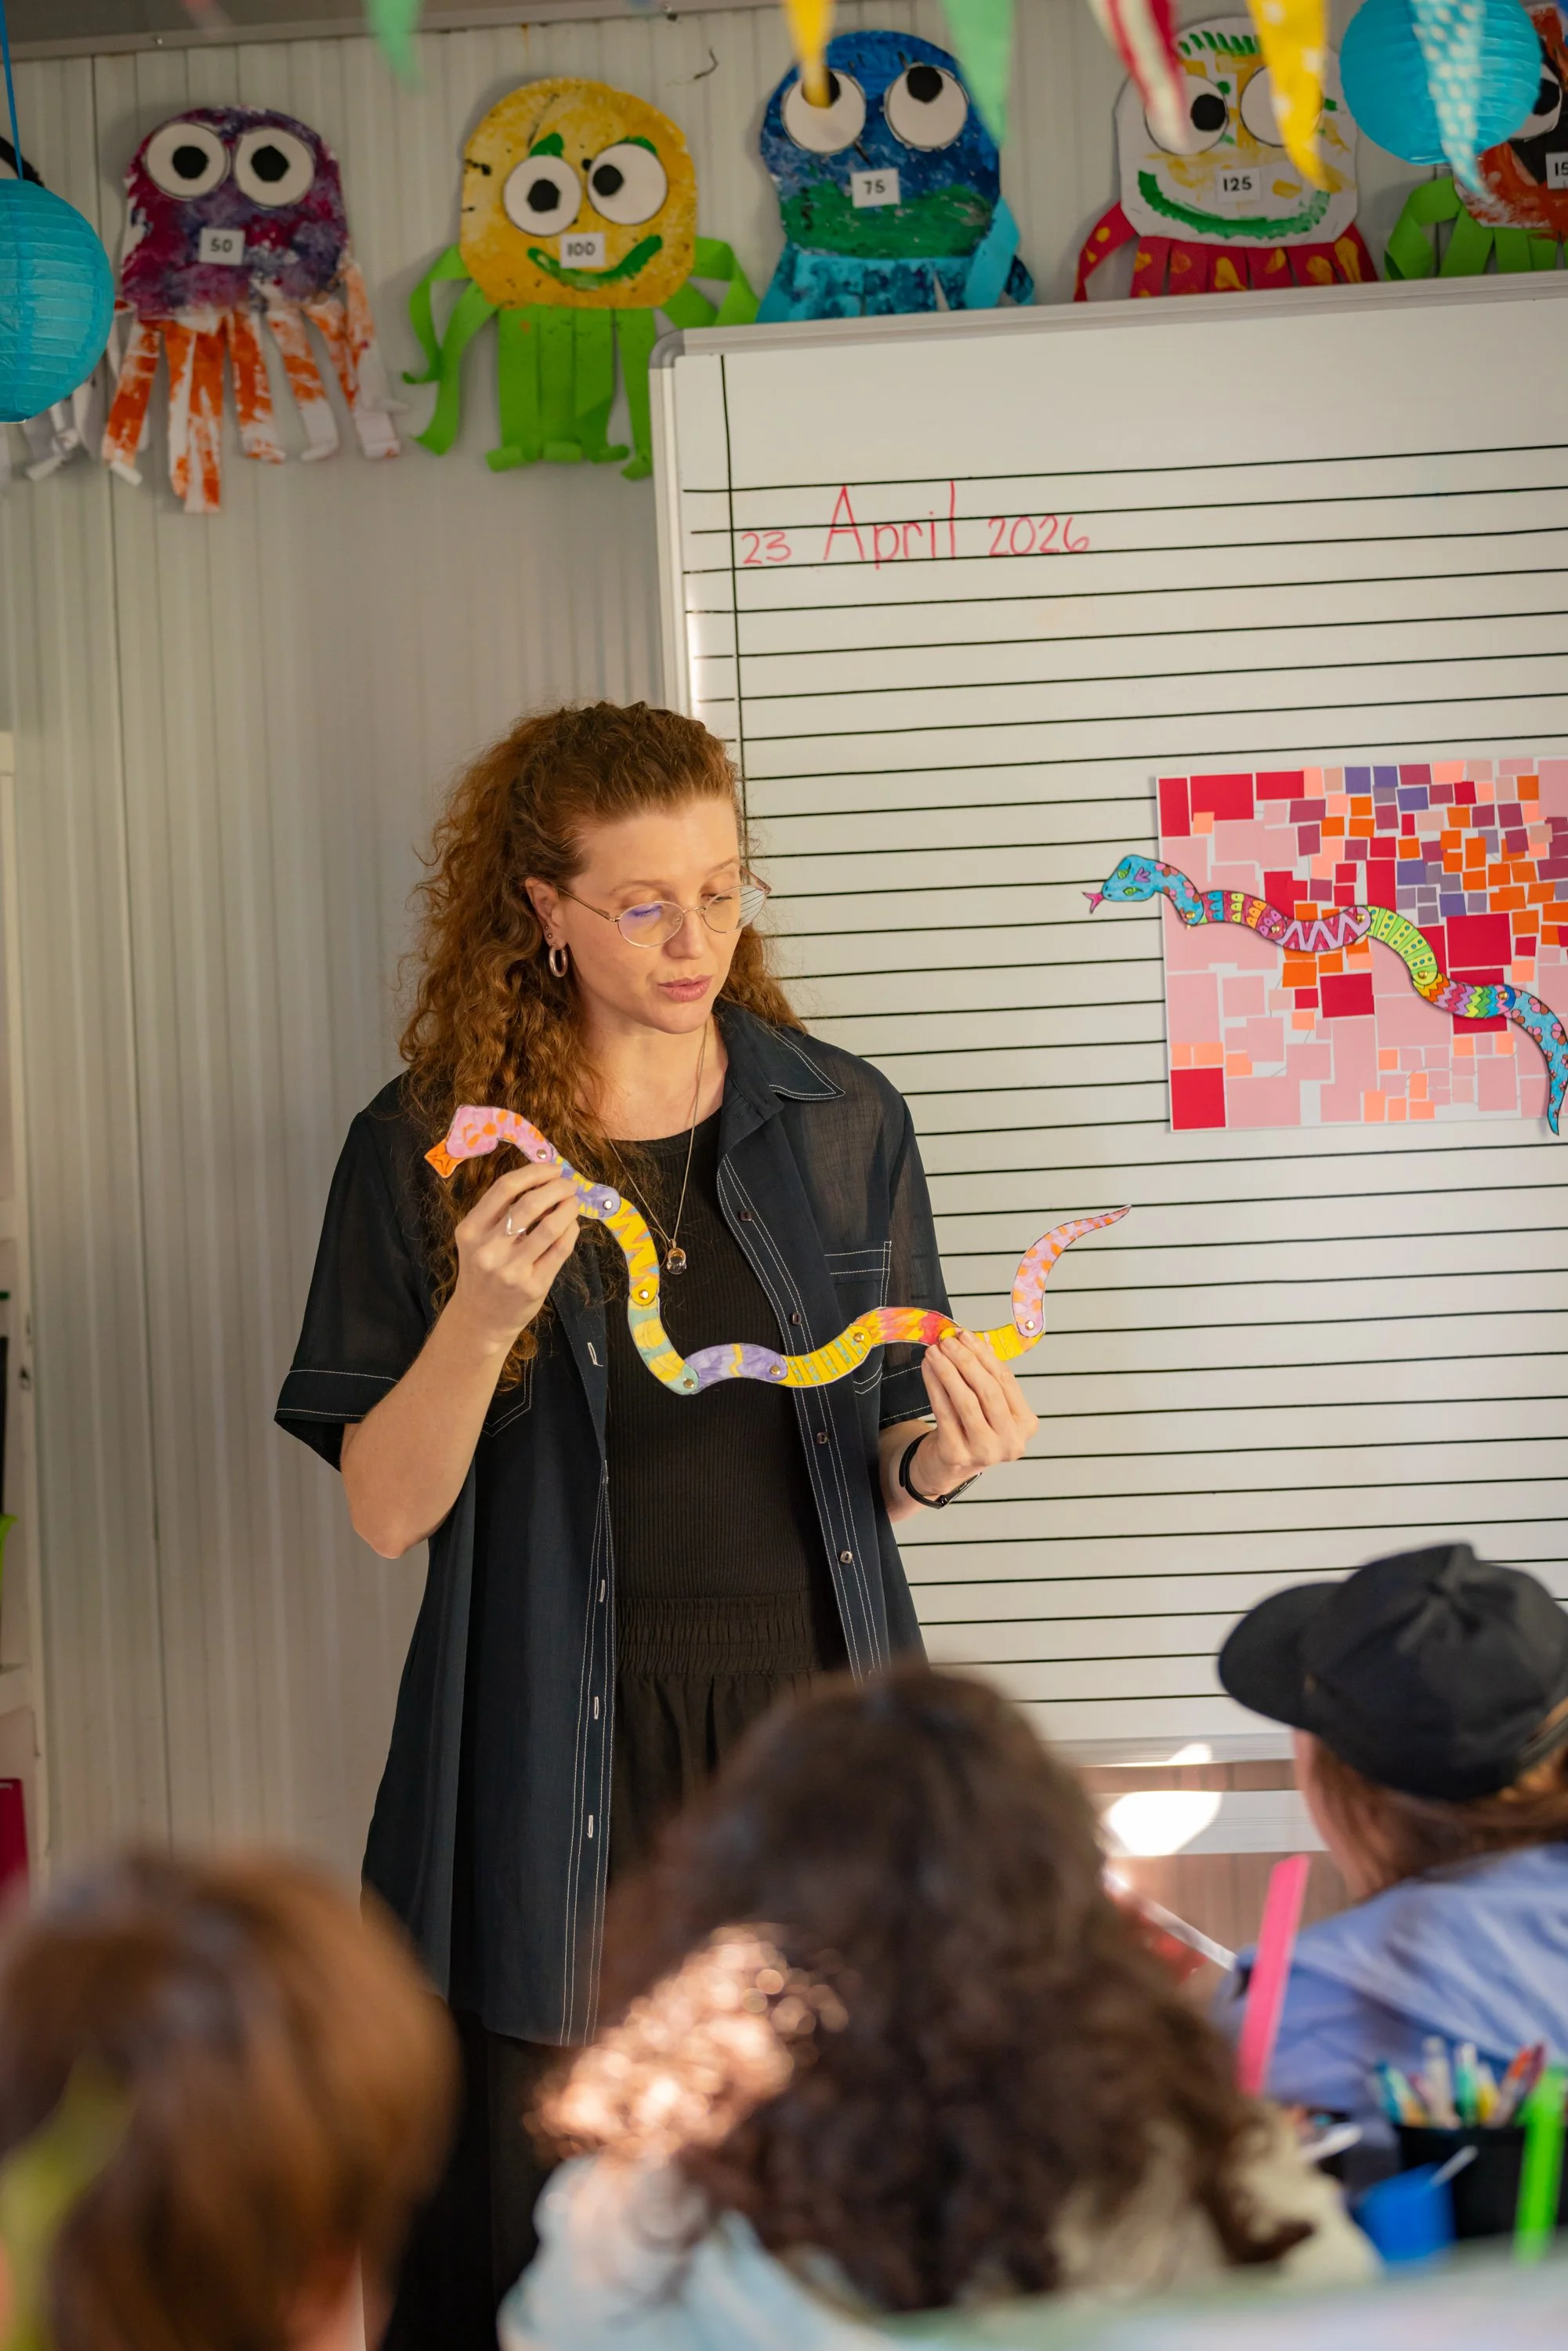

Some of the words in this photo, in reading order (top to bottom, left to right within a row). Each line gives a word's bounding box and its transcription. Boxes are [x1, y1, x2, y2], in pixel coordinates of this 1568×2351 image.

[1555, 161, 1568, 177] 15
[863, 179, 886, 195] 75
[1223, 175, 1252, 193] 125
[210, 237, 234, 254] 50
[567, 241, 596, 258] 100
[741, 531, 792, 565] 23
[823, 480, 957, 571] April
[987, 514, 1091, 558] 2026
